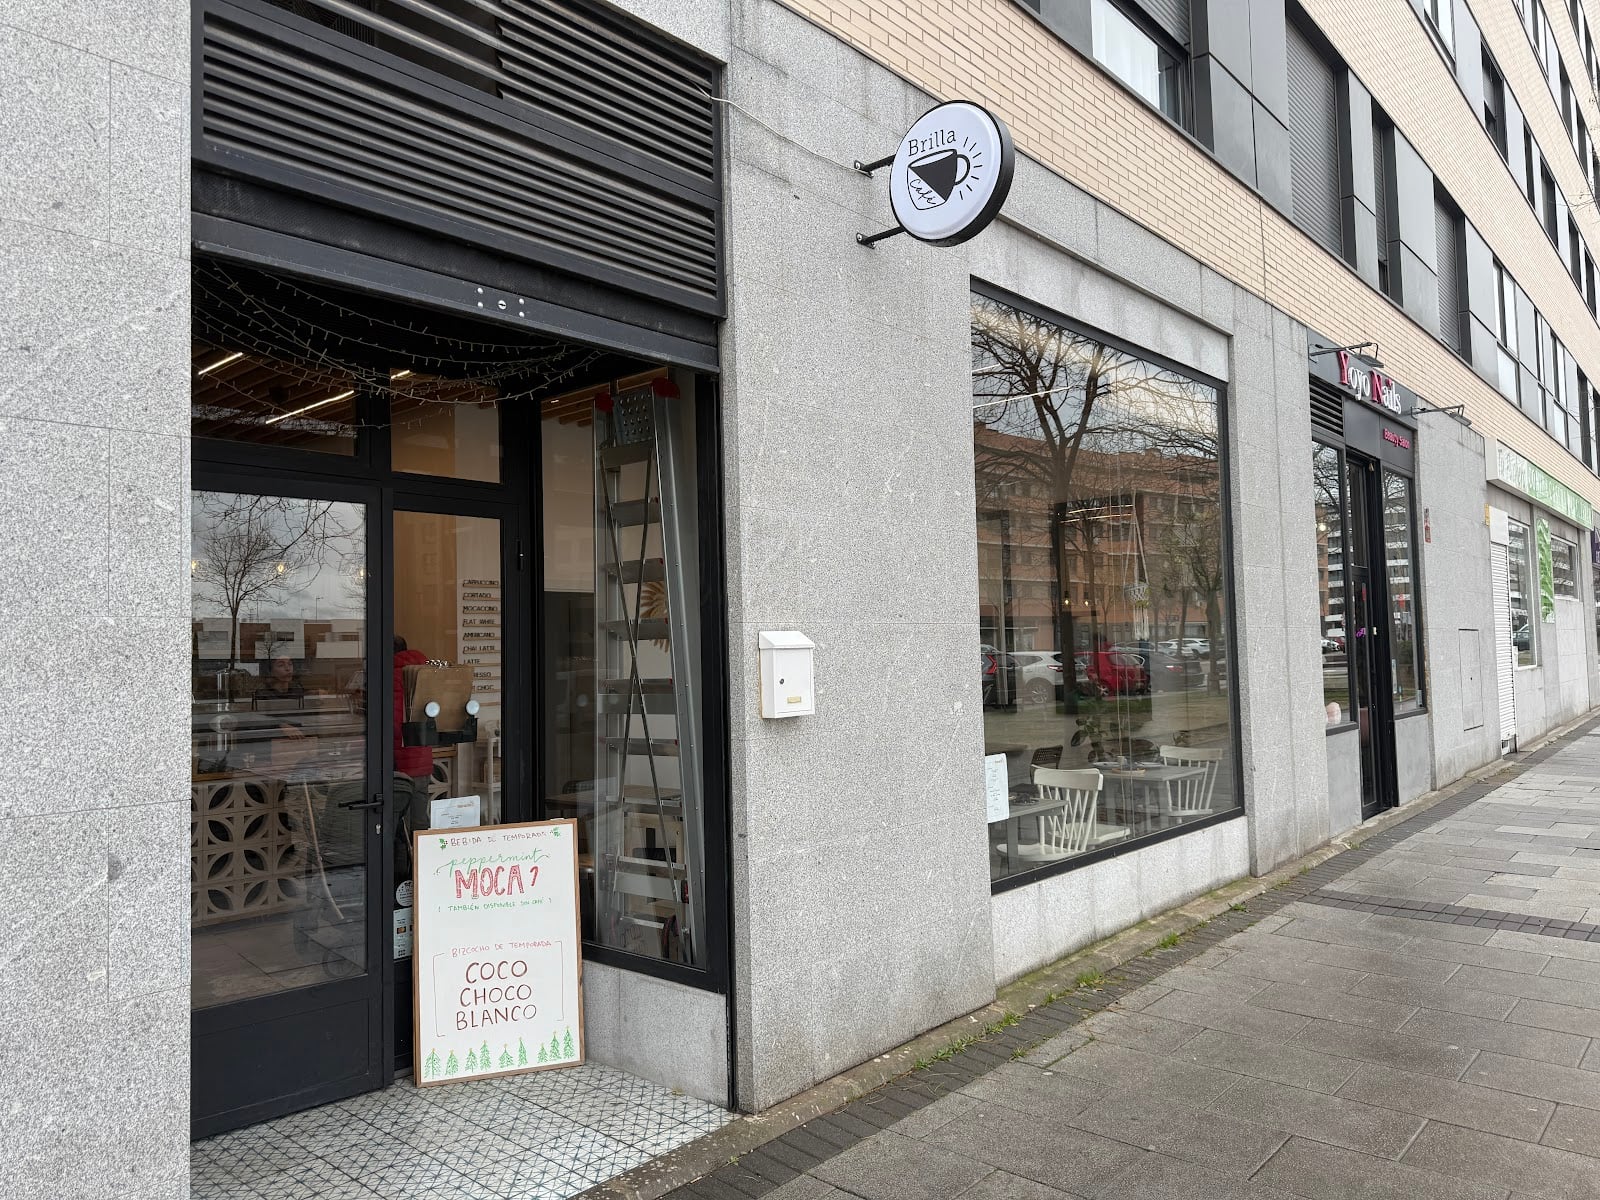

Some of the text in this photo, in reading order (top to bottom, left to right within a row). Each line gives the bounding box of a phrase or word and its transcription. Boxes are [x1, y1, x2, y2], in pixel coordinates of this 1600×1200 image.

[908, 129, 957, 157] Brilla
[909, 178, 937, 206] Café
[1336, 350, 1402, 415] Yoyo Nails
[450, 835, 482, 847] BEBIDA
[436, 847, 549, 878] peppermint
[447, 902, 480, 912] TAMBIÉN
[450, 939, 553, 958] BIZCOCHO DE TEMPORADA
[465, 960, 528, 984] COCO
[459, 983, 532, 1008] CHOCO
[456, 1004, 537, 1031] BLANCO
